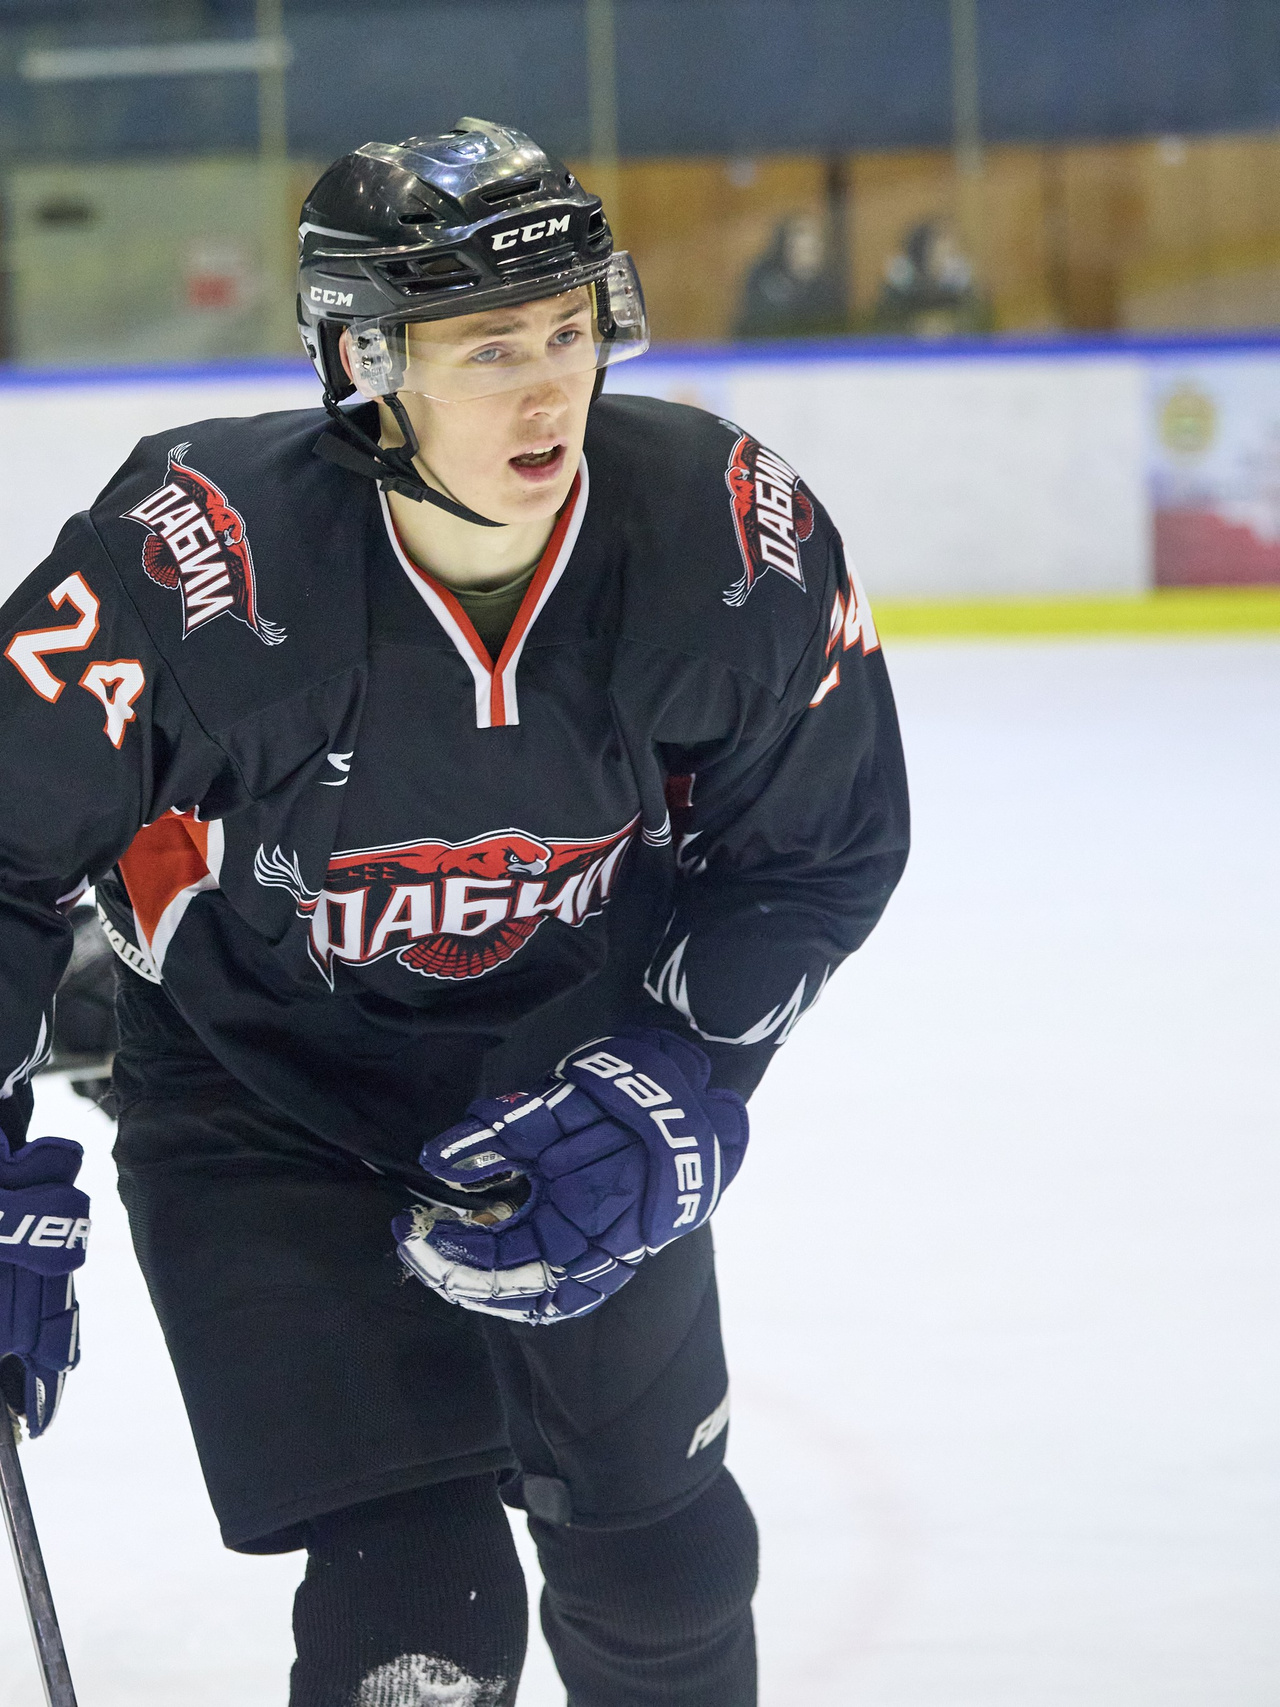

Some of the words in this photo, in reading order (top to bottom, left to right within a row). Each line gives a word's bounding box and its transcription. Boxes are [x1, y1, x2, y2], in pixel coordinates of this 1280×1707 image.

[491, 213, 572, 252] CCM
[309, 285, 354, 307] CCM
[3, 570, 146, 749] 24
